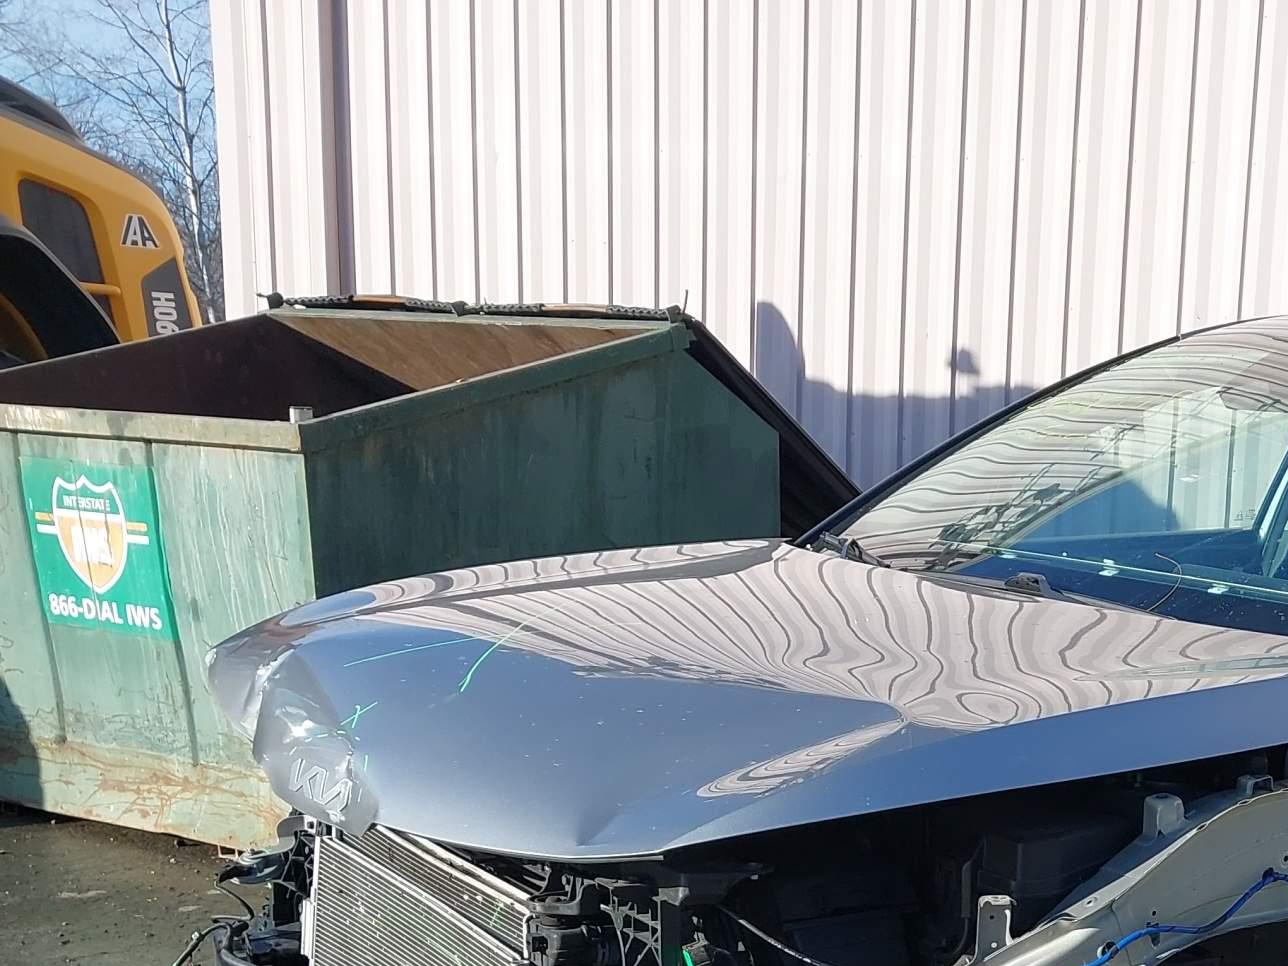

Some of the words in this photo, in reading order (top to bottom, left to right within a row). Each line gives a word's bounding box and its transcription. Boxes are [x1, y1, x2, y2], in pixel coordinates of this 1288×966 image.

[62, 495, 111, 512] INTERSTATE
[49, 593, 124, 624] 866-DIAL
[126, 603, 163, 631] IWS
